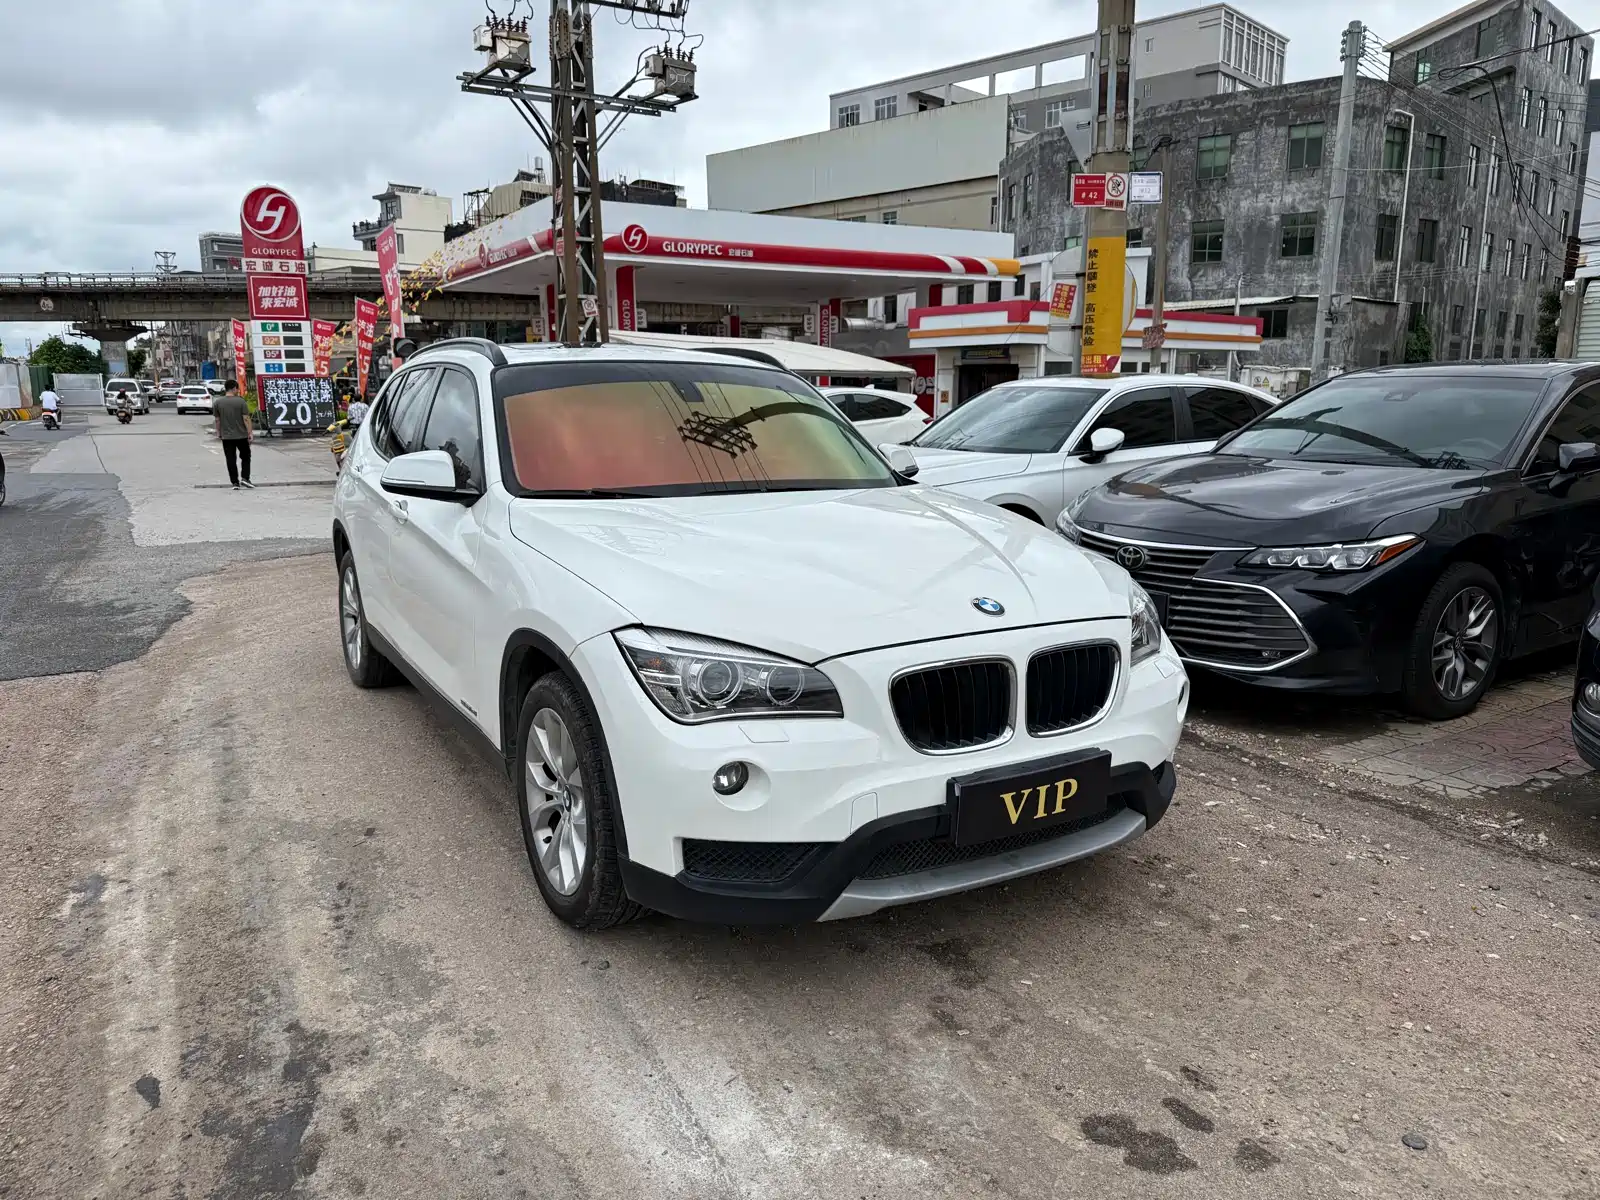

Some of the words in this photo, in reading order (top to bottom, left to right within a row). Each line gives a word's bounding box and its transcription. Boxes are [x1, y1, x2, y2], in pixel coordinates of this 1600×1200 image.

[1088, 191, 1098, 199] 42
[251, 247, 298, 257] GLORYPEC
[662, 241, 723, 256] GLORYPEC
[245, 260, 306, 272] 宏诚石油
[258, 285, 297, 297] 加好油
[261, 297, 299, 310] 来宏诚
[1083, 302, 1096, 346] 高压危险
[274, 403, 312, 425] 2.0
[1000, 778, 1078, 825] VIP
